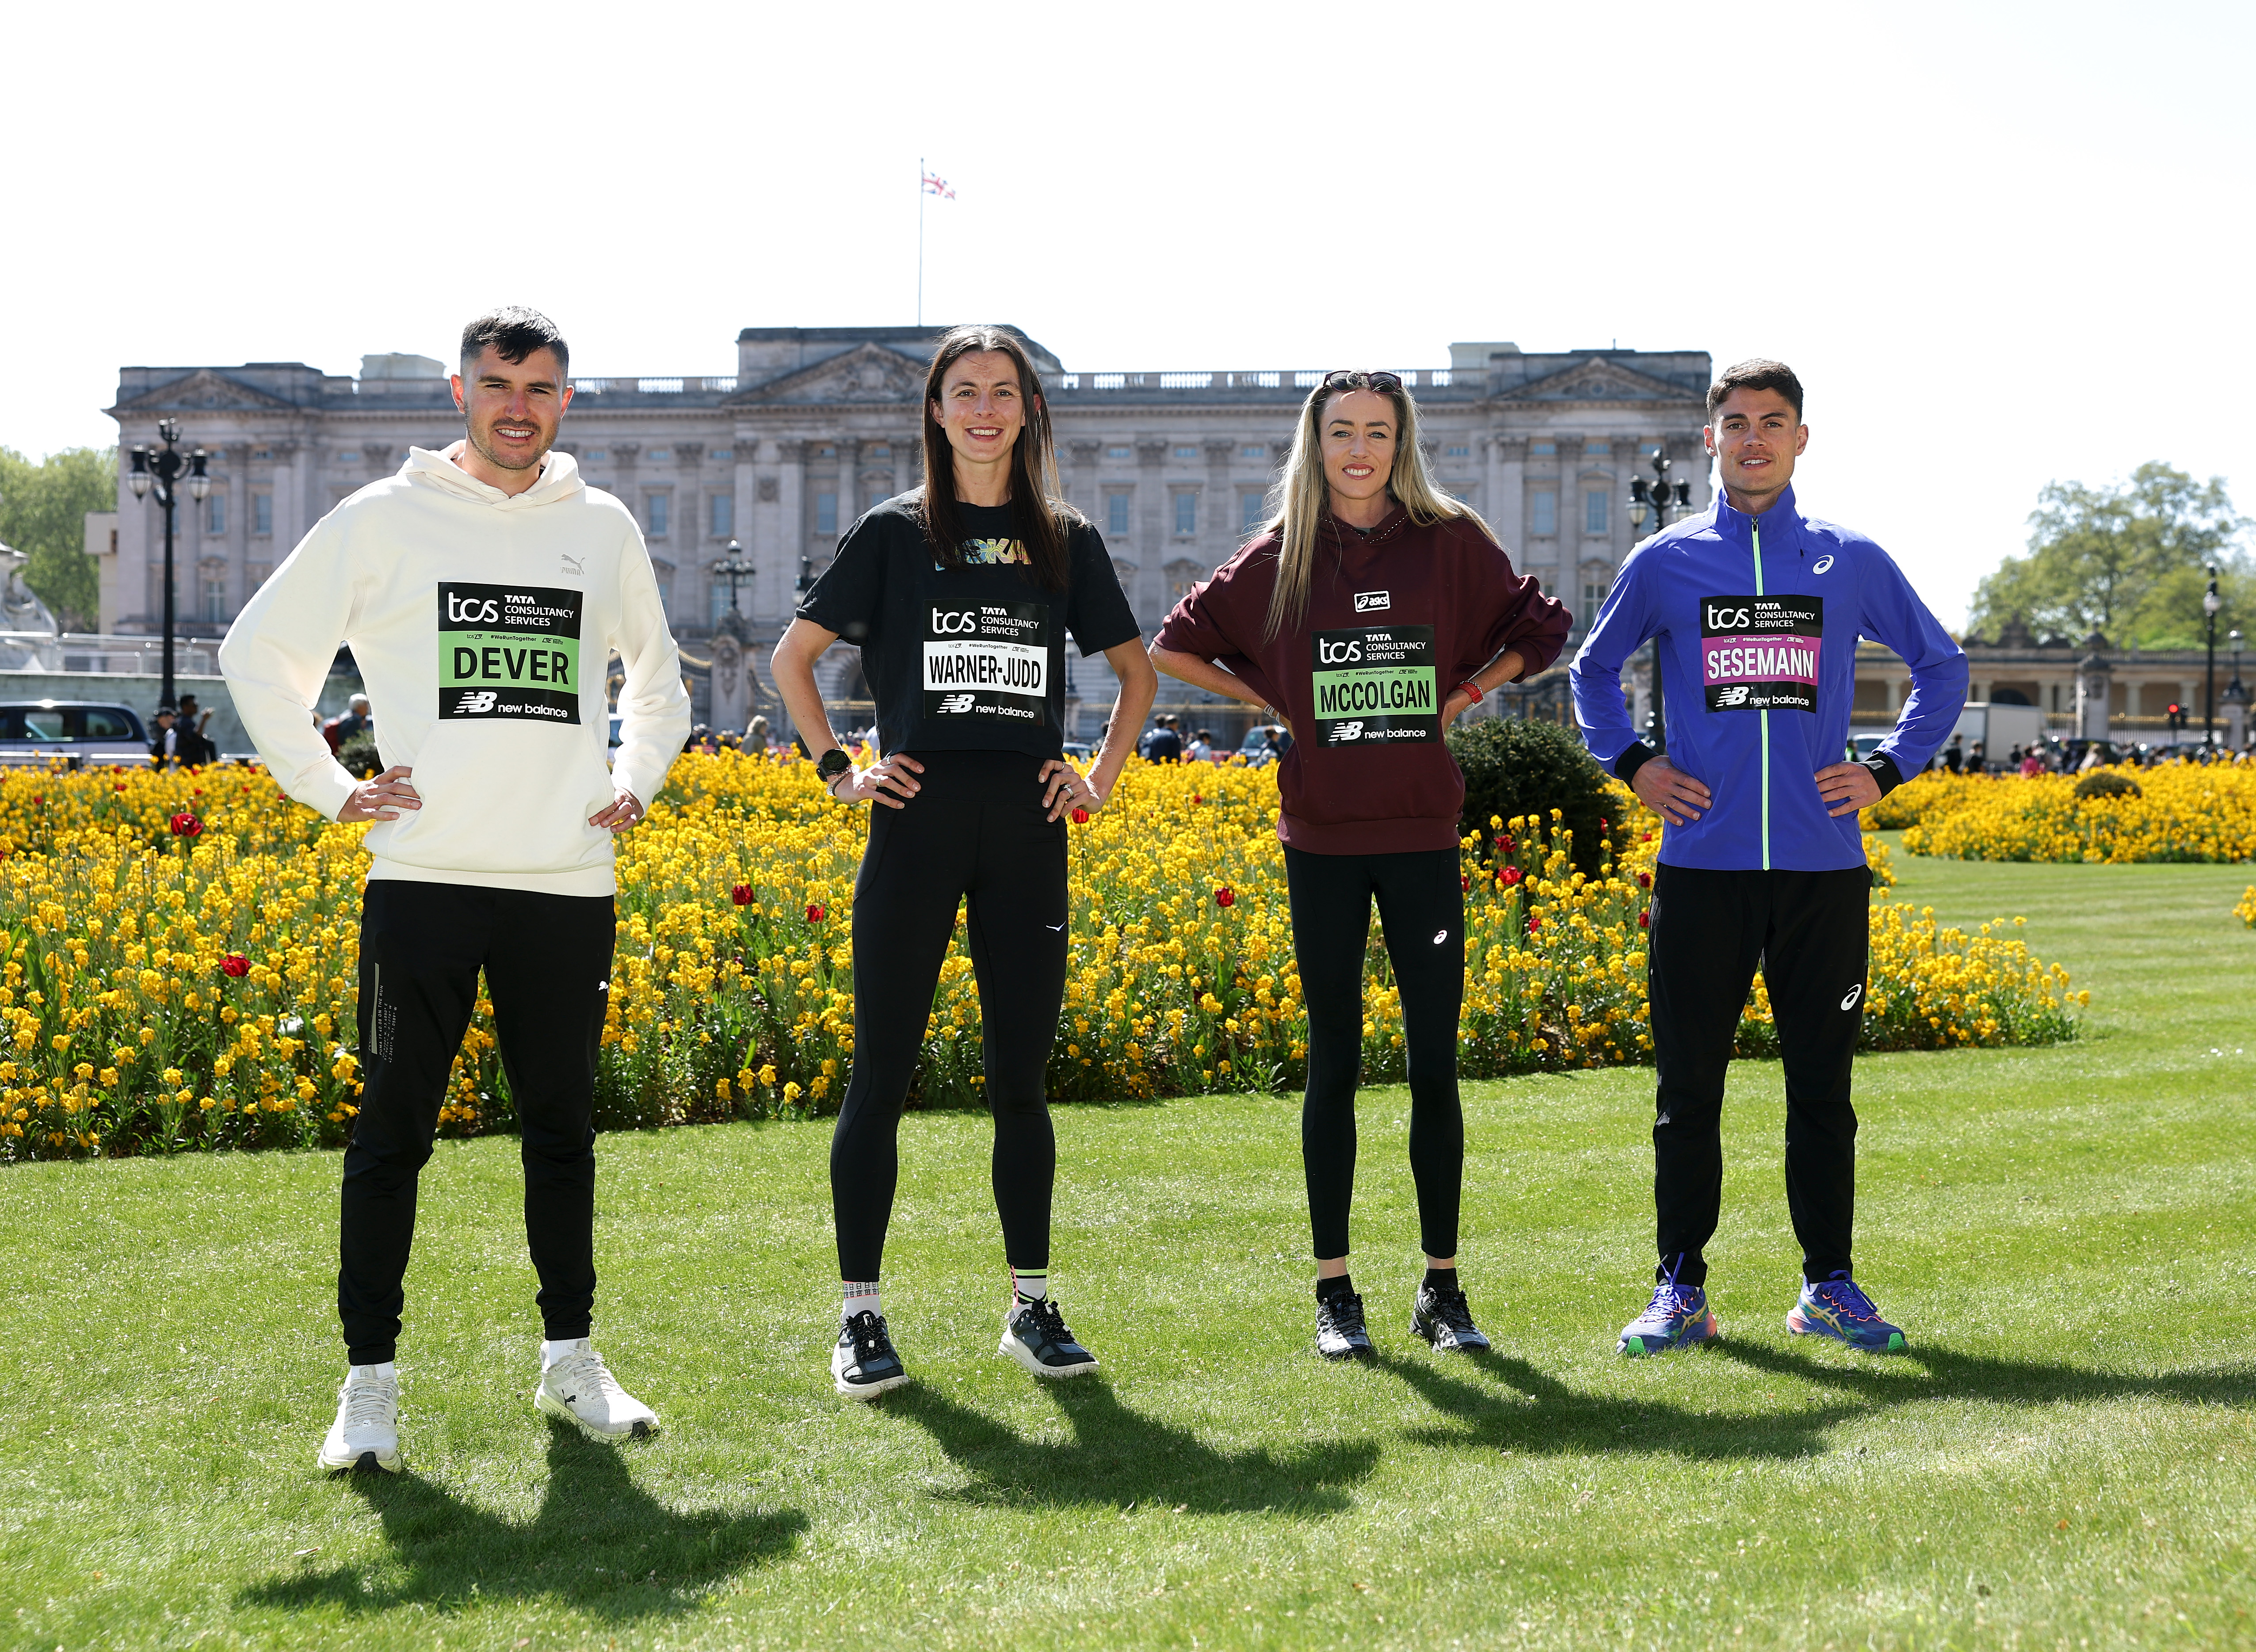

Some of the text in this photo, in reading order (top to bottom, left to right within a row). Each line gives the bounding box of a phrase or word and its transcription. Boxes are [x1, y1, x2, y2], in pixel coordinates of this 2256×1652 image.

[935, 538, 1032, 571] OKA
[561, 566, 580, 576] PUMA
[504, 595, 535, 604] TATA
[448, 592, 499, 623] tcs
[504, 605, 574, 618] CONSULTANCY
[981, 607, 1007, 615] TATA
[504, 616, 550, 626] SERVICES
[932, 607, 976, 634] tcs
[1708, 604, 1749, 630] tcs
[1755, 611, 1815, 620] CONSULTANCY
[981, 617, 1039, 629] CONSULTANCY
[981, 626, 1019, 636] SERVICES
[1320, 638, 1362, 663] tcs
[1366, 642, 1426, 651] CONSULTANCY
[1367, 652, 1405, 660] SERVICES
[454, 647, 569, 685] DEVER
[1708, 647, 1814, 679] SESEMANN
[929, 655, 1041, 689] WARNER-JUDD
[1320, 680, 1430, 713] MCCOLGAN
[1772, 695, 1809, 706] balance
[498, 703, 568, 718] new balance
[976, 705, 1034, 718] new balance
[1365, 729, 1426, 739] new balance
